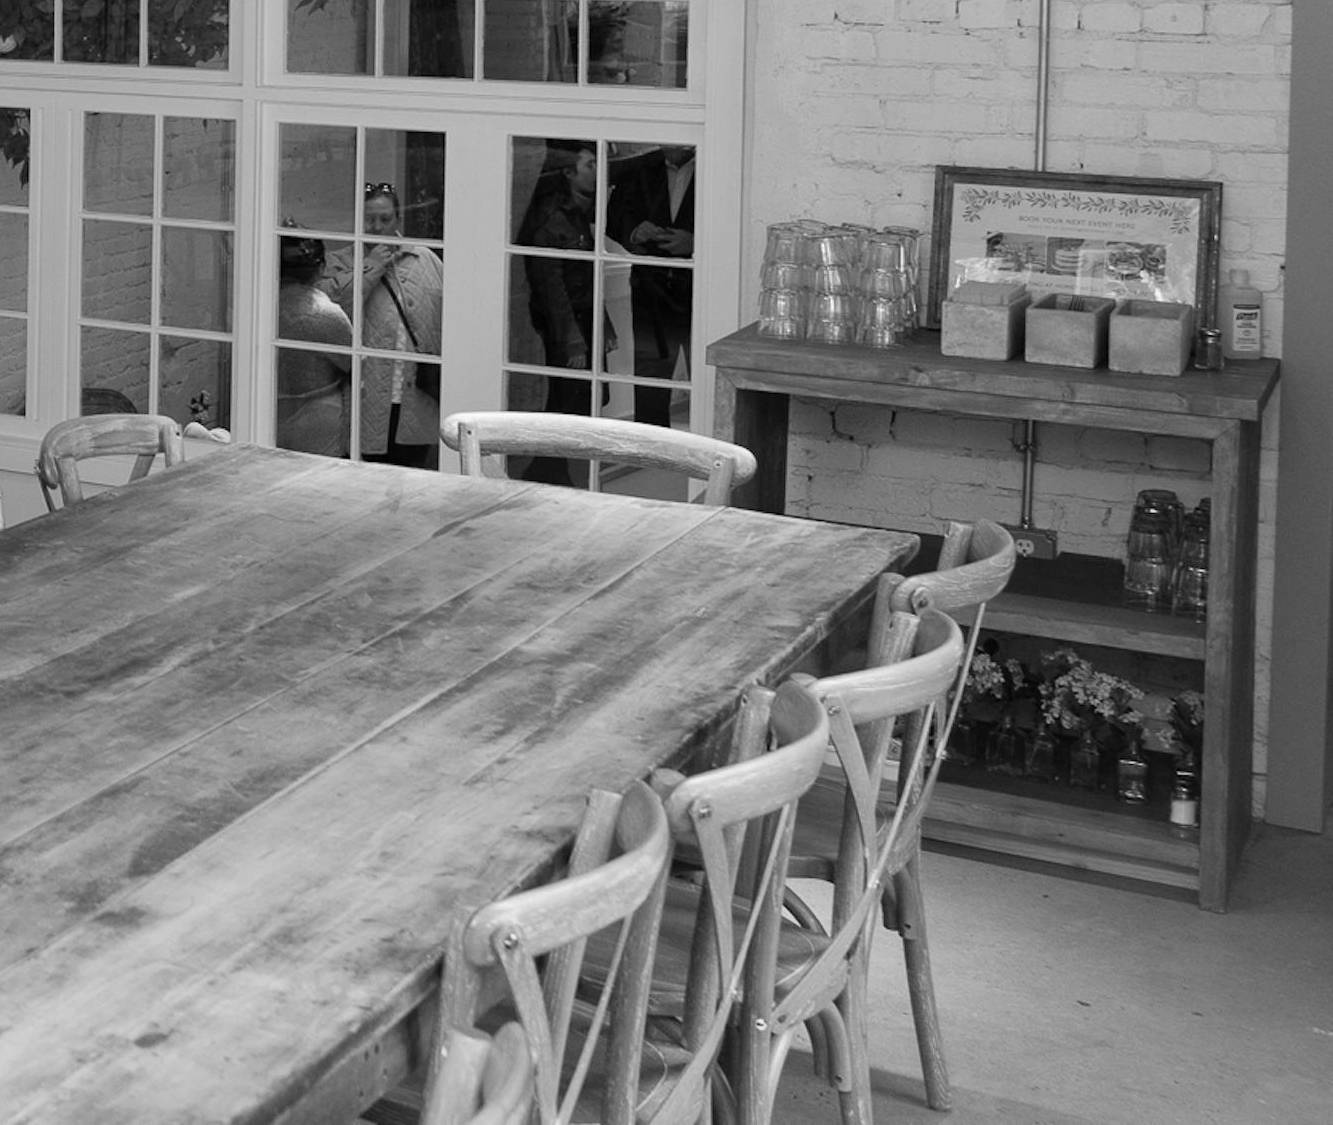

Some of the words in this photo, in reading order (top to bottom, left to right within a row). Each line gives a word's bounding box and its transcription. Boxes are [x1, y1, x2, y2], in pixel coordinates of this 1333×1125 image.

[1043, 217, 1063, 225] YOUR
[1088, 220, 1113, 228] EVENT
[1115, 222, 1136, 230] HERE
